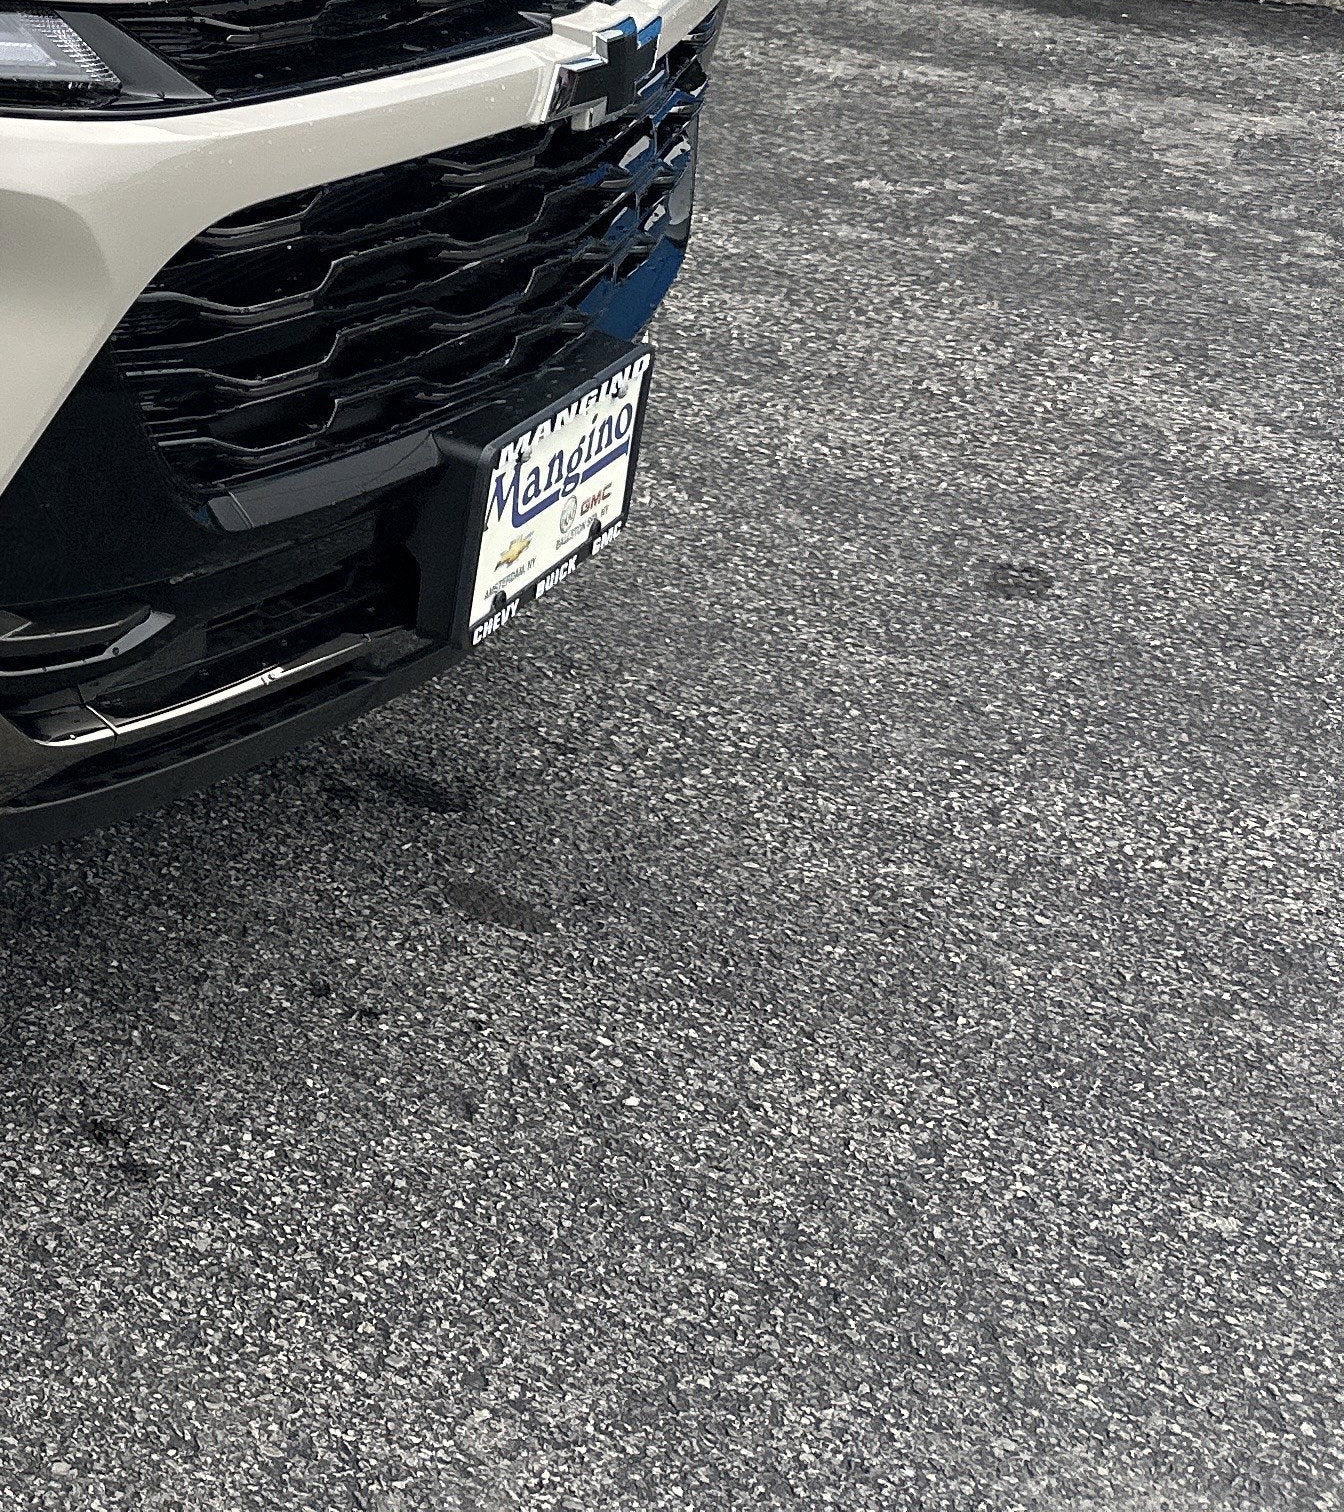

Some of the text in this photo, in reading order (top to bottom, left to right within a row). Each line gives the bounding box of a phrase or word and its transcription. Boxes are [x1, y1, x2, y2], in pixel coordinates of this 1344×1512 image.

[482, 402, 633, 528] Mangino
[498, 353, 651, 470] MANGINO
[579, 481, 613, 517] GMC
[472, 520, 623, 647] CHEVY BUICK GMC
